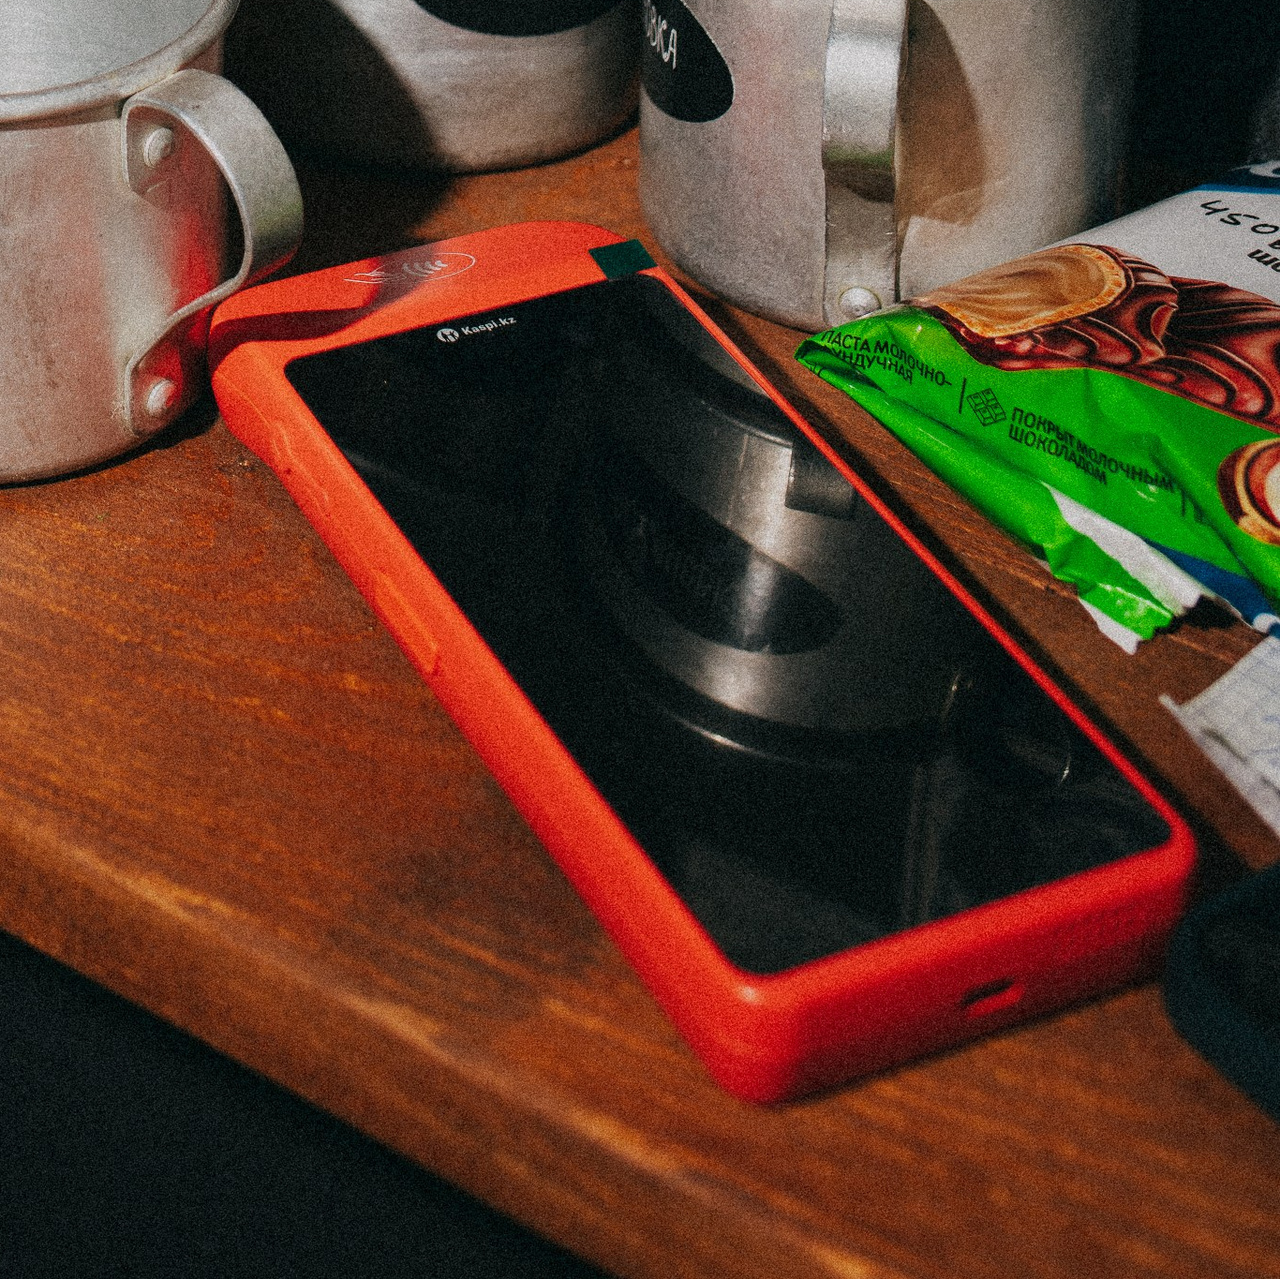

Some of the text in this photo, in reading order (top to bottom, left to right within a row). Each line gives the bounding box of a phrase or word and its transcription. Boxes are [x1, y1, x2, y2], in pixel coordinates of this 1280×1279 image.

[461, 316, 518, 337] Kaspi.kz
[820, 330, 953, 387] ПАСТА МОЛОЧНО-
[1008, 423, 1108, 486] ШОКОЛАДОМ
[1011, 406, 1178, 494] ПОКРЫТ МОЛОЧНЫМ
